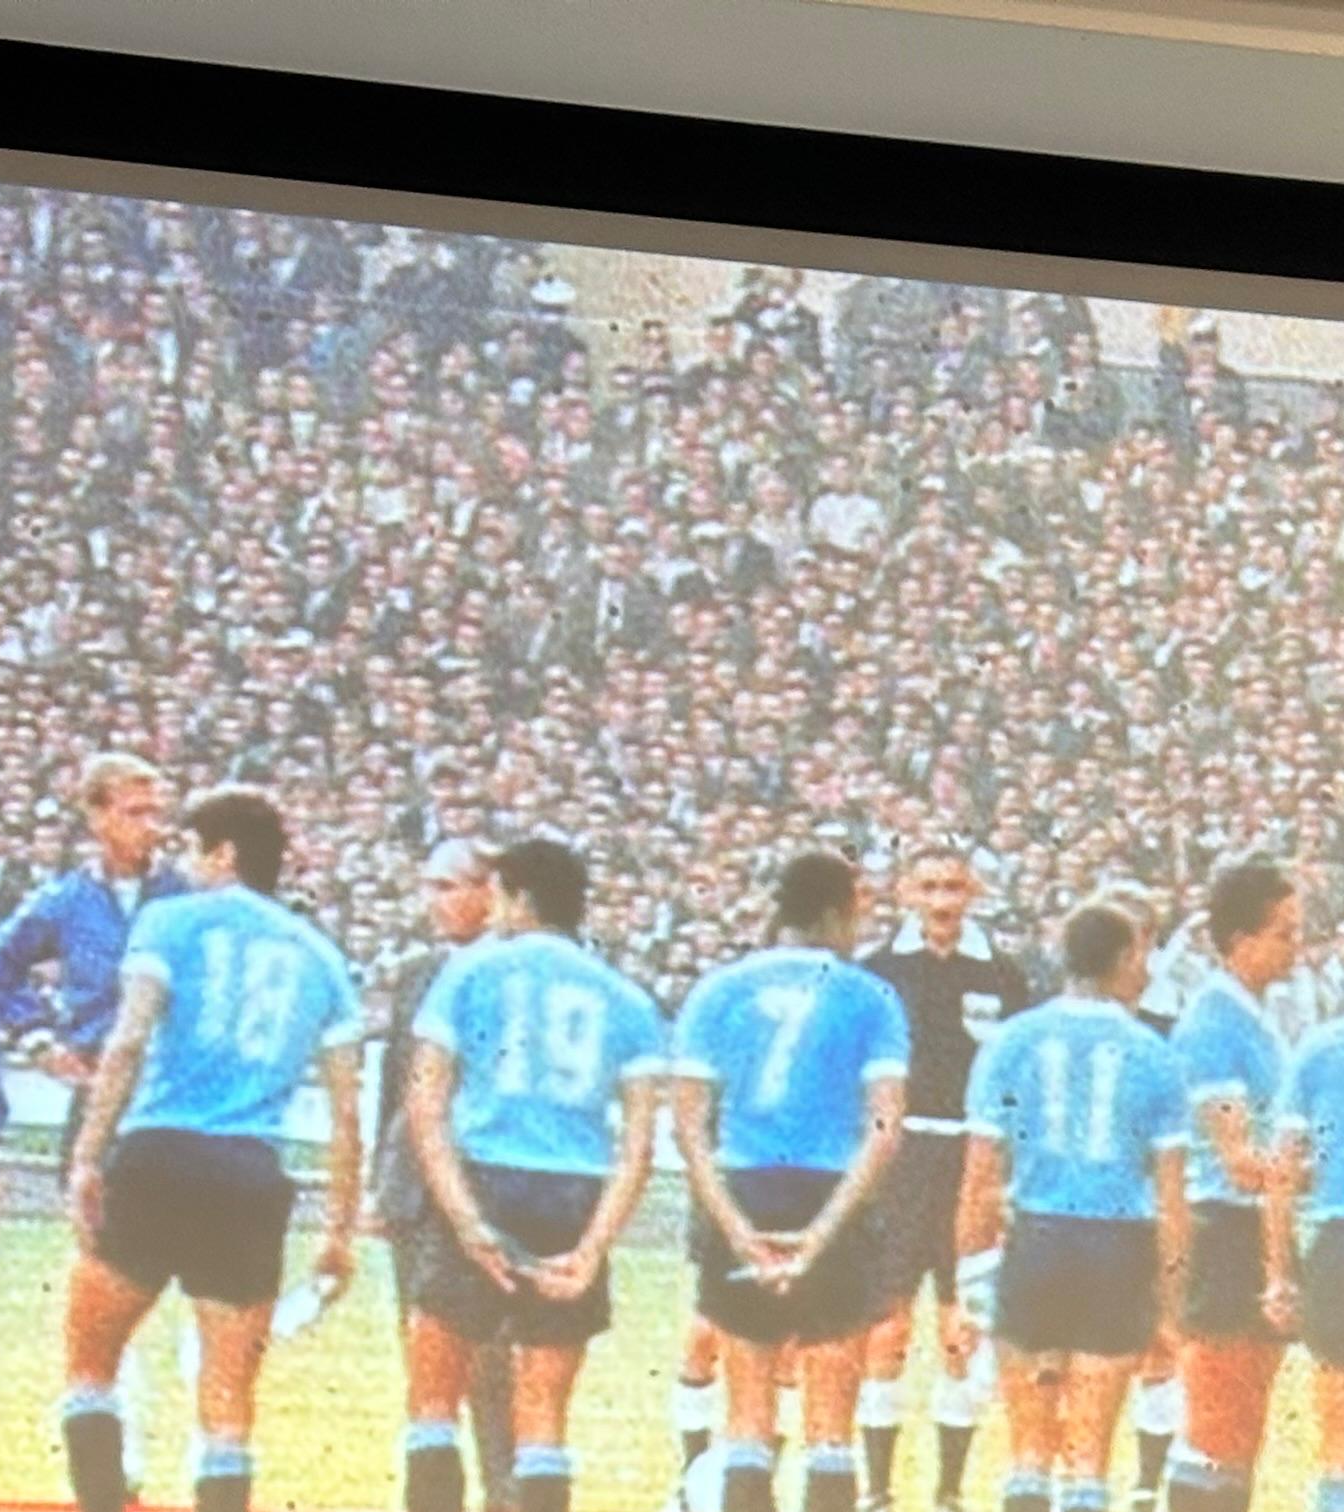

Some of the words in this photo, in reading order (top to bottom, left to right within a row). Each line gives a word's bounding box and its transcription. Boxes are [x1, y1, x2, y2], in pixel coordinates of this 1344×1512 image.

[492, 970, 606, 1106] 19
[748, 985, 819, 1109] 7
[1038, 1038, 1124, 1162] 11
